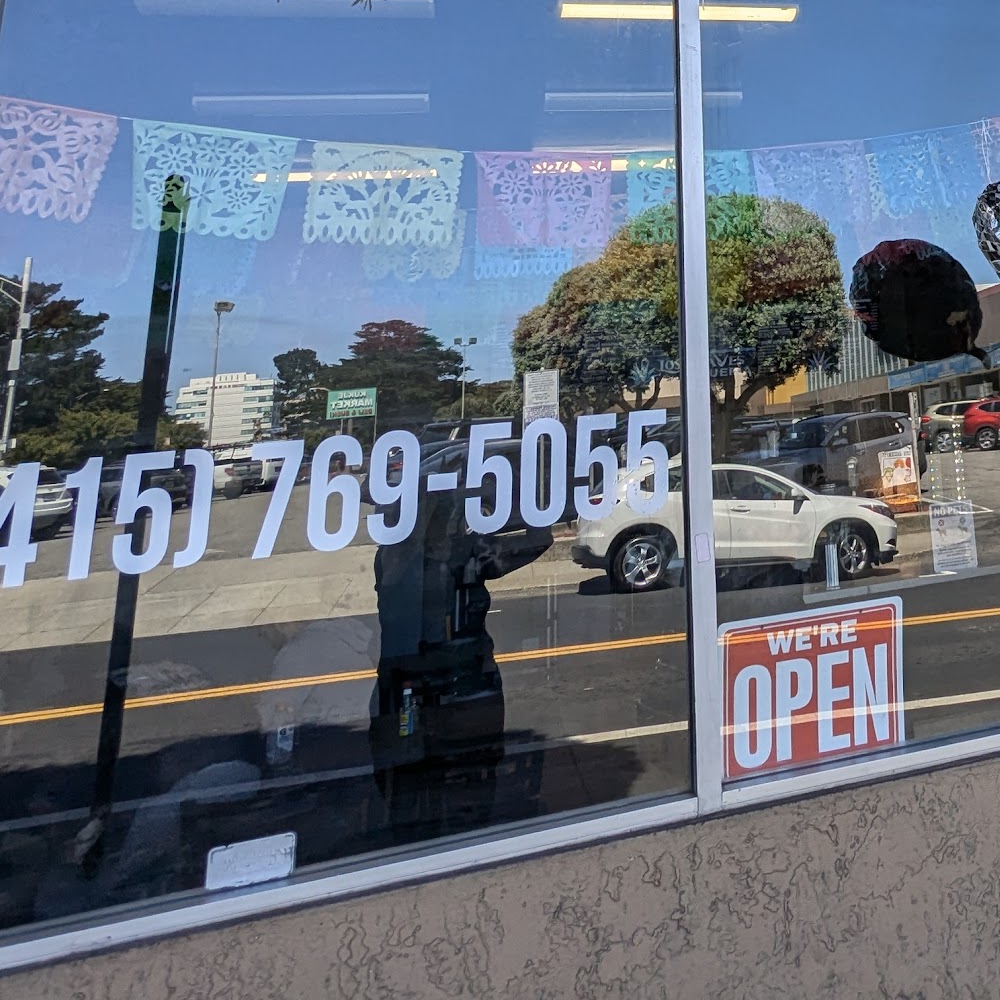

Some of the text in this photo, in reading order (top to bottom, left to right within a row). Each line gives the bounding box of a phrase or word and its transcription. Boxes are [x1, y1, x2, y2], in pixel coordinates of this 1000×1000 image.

[251, 408, 669, 560] 769-5055
[933, 506, 946, 516] NO
[766, 618, 858, 656] WE'RE
[733, 642, 890, 769] OPEN
